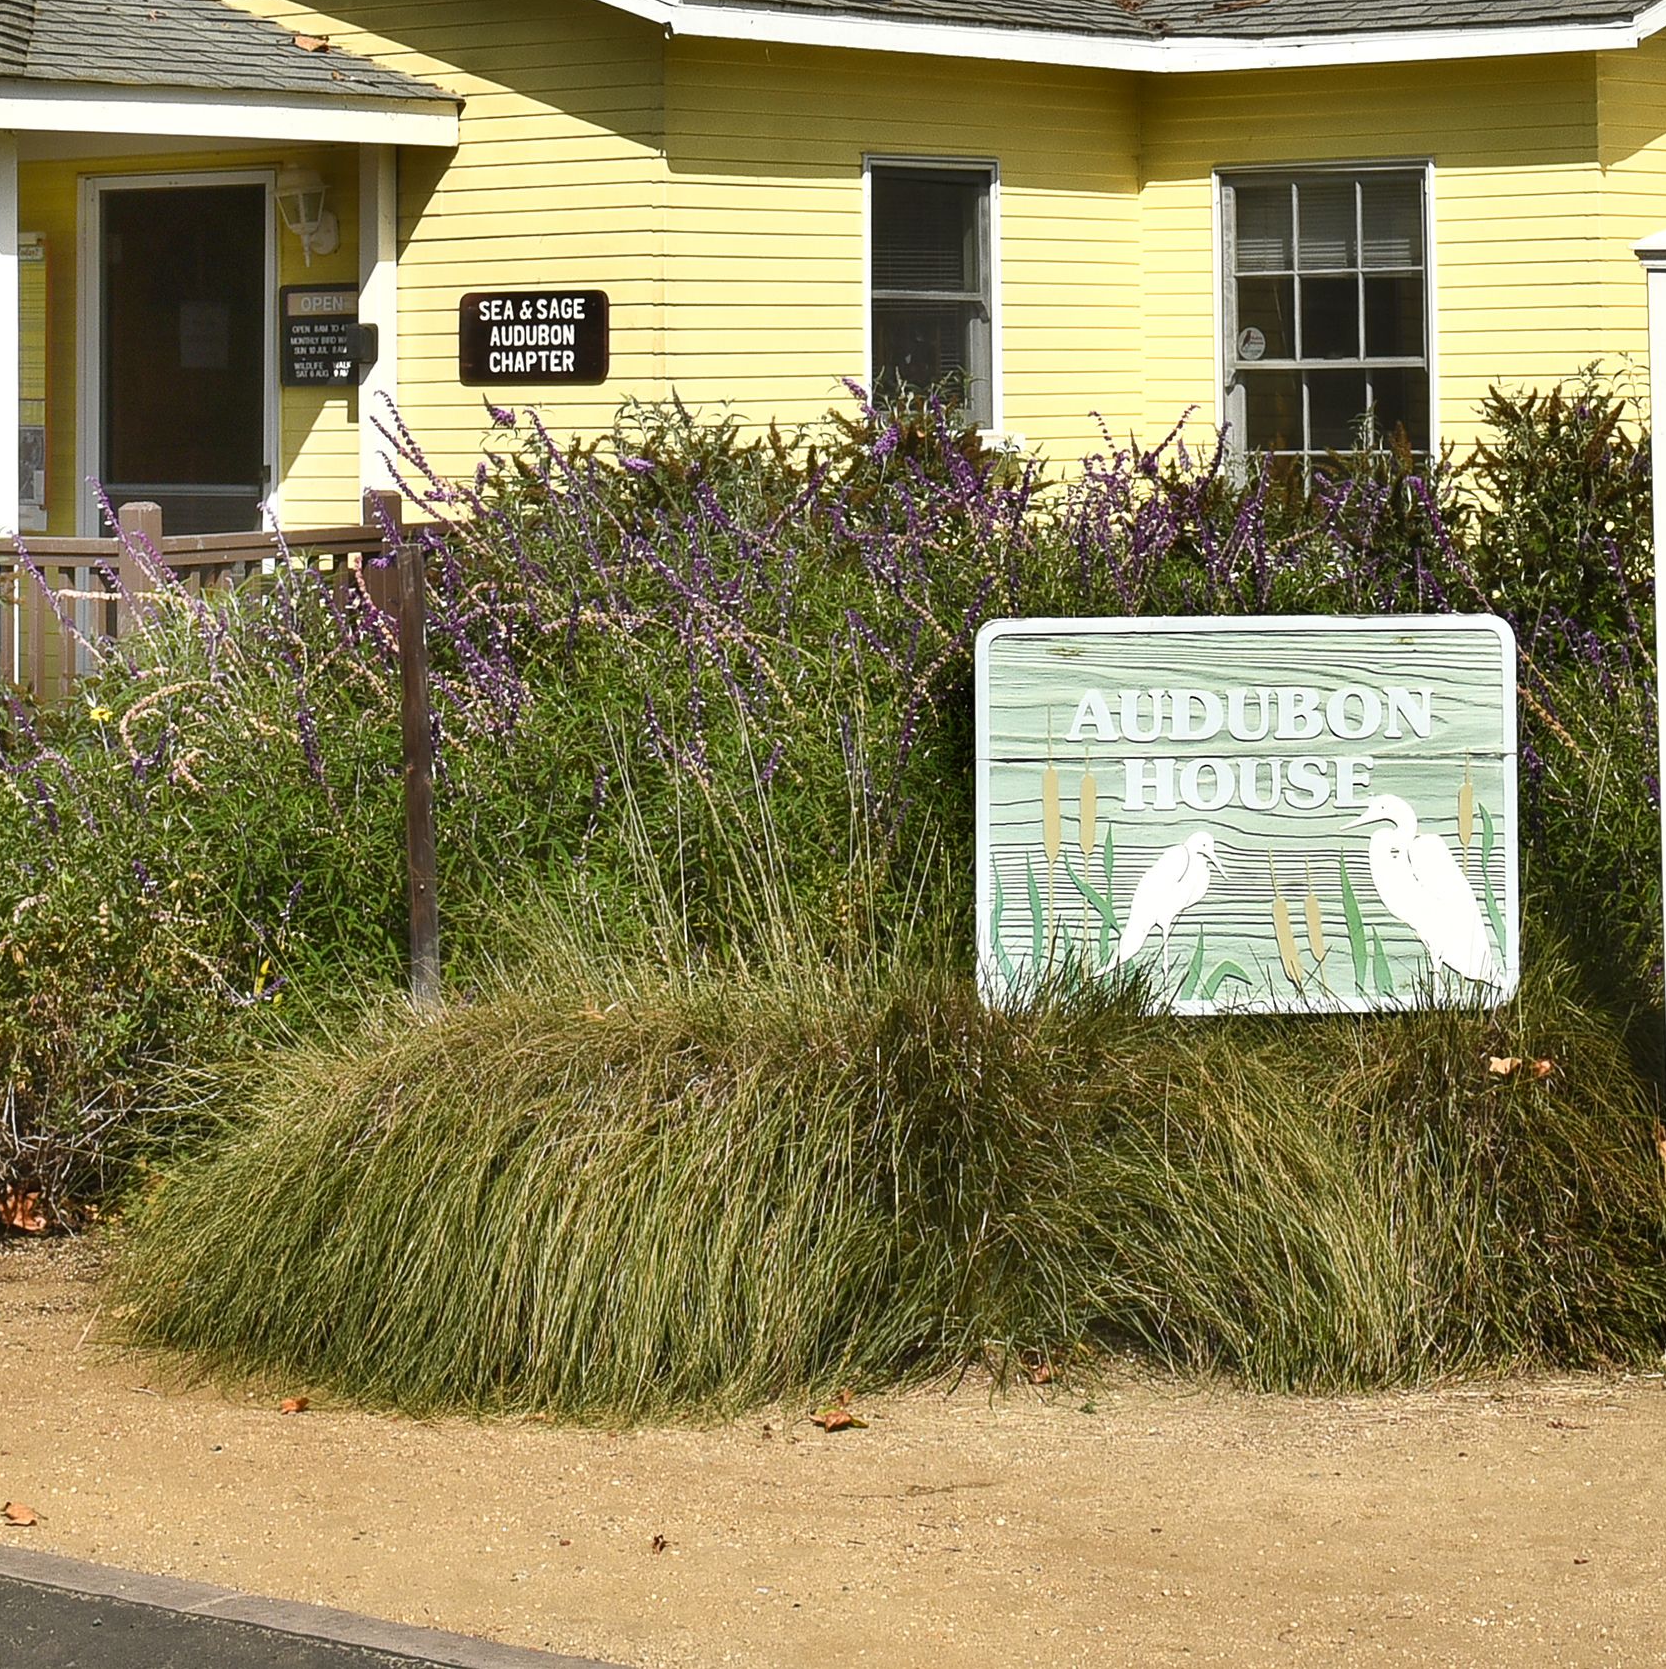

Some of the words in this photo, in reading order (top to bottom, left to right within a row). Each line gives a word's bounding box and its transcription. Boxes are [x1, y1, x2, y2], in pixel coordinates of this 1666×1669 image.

[301, 296, 343, 311] OPEN
[478, 299, 514, 321] SEA
[519, 300, 533, 320] &
[536, 297, 586, 320] SAGE
[292, 325, 311, 333] OPEN
[331, 324, 339, 332] TO
[489, 324, 575, 347] AUDUBON
[290, 336, 319, 345] MONTHLY
[321, 336, 337, 344] BIRD
[294, 346, 306, 354] SUN
[317, 346, 328, 354] JUL
[294, 361, 323, 370] WILDLIFE
[333, 360, 352, 369] WALK
[489, 350, 575, 373] CHAPTER
[295, 370, 309, 378] SAT
[315, 370, 329, 378] AUG
[1064, 685, 1433, 743] AUDUBON
[1119, 755, 1375, 812] HOUSE
